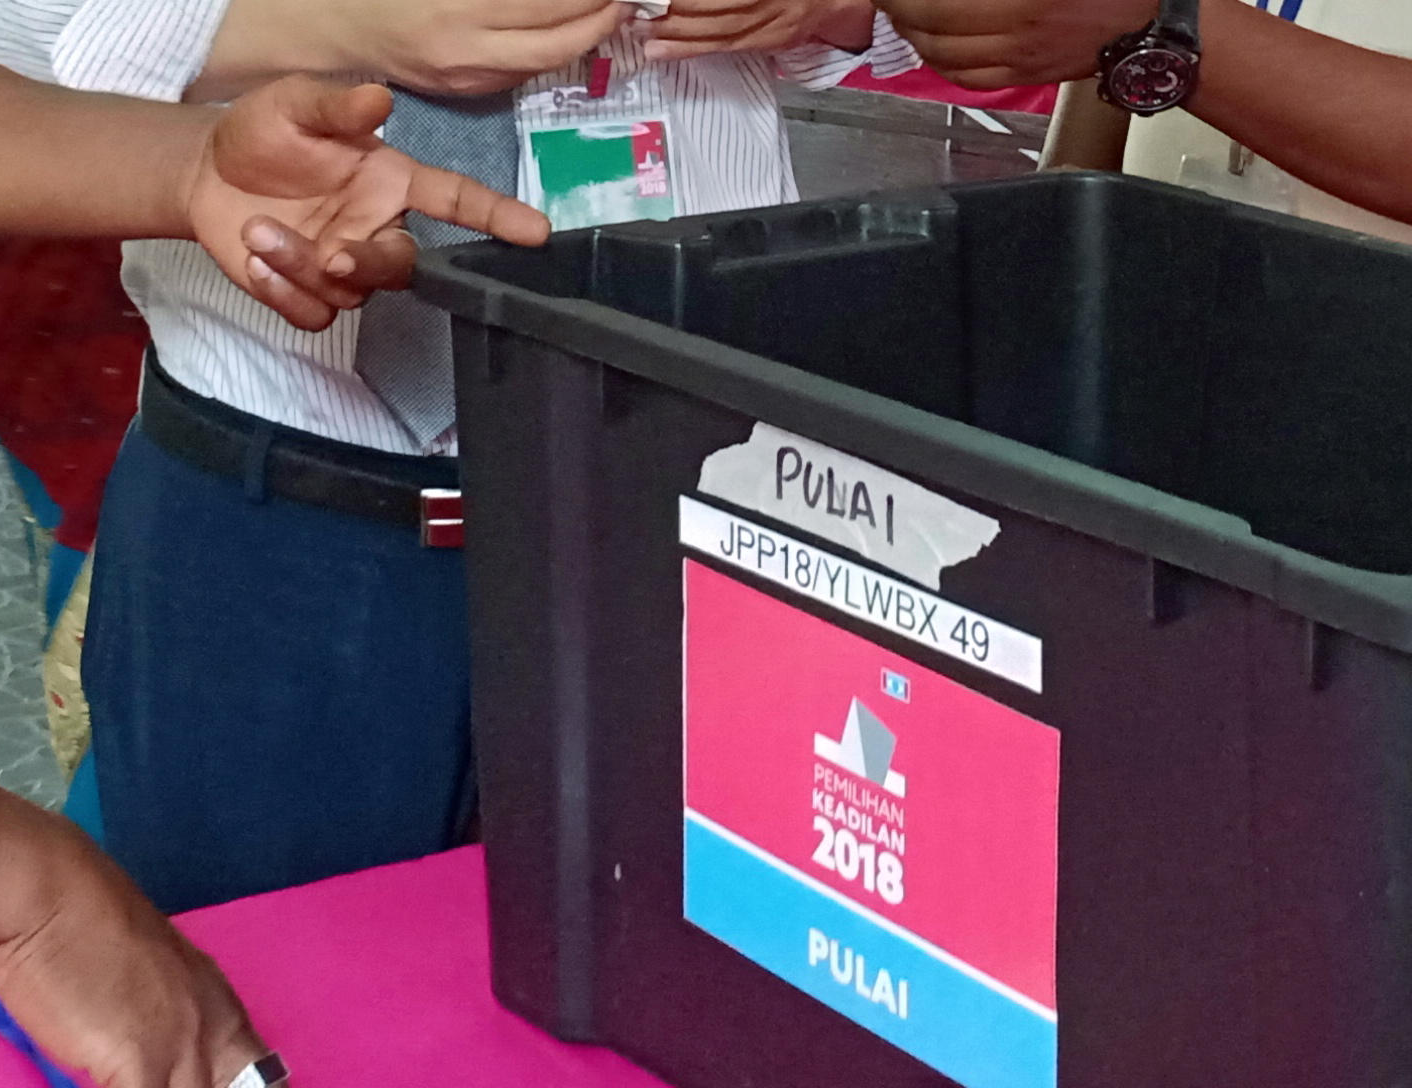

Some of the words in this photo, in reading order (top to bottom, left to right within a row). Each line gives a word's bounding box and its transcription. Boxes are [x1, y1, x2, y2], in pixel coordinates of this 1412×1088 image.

[776, 446, 894, 545] PULAI
[720, 521, 938, 643] JPP18/YLWBX
[950, 615, 990, 662] 49
[811, 787, 906, 857] KEADILAN
[813, 762, 904, 830] PEMILIHAN
[811, 814, 905, 905] 2018
[808, 927, 909, 1021] PULAI
